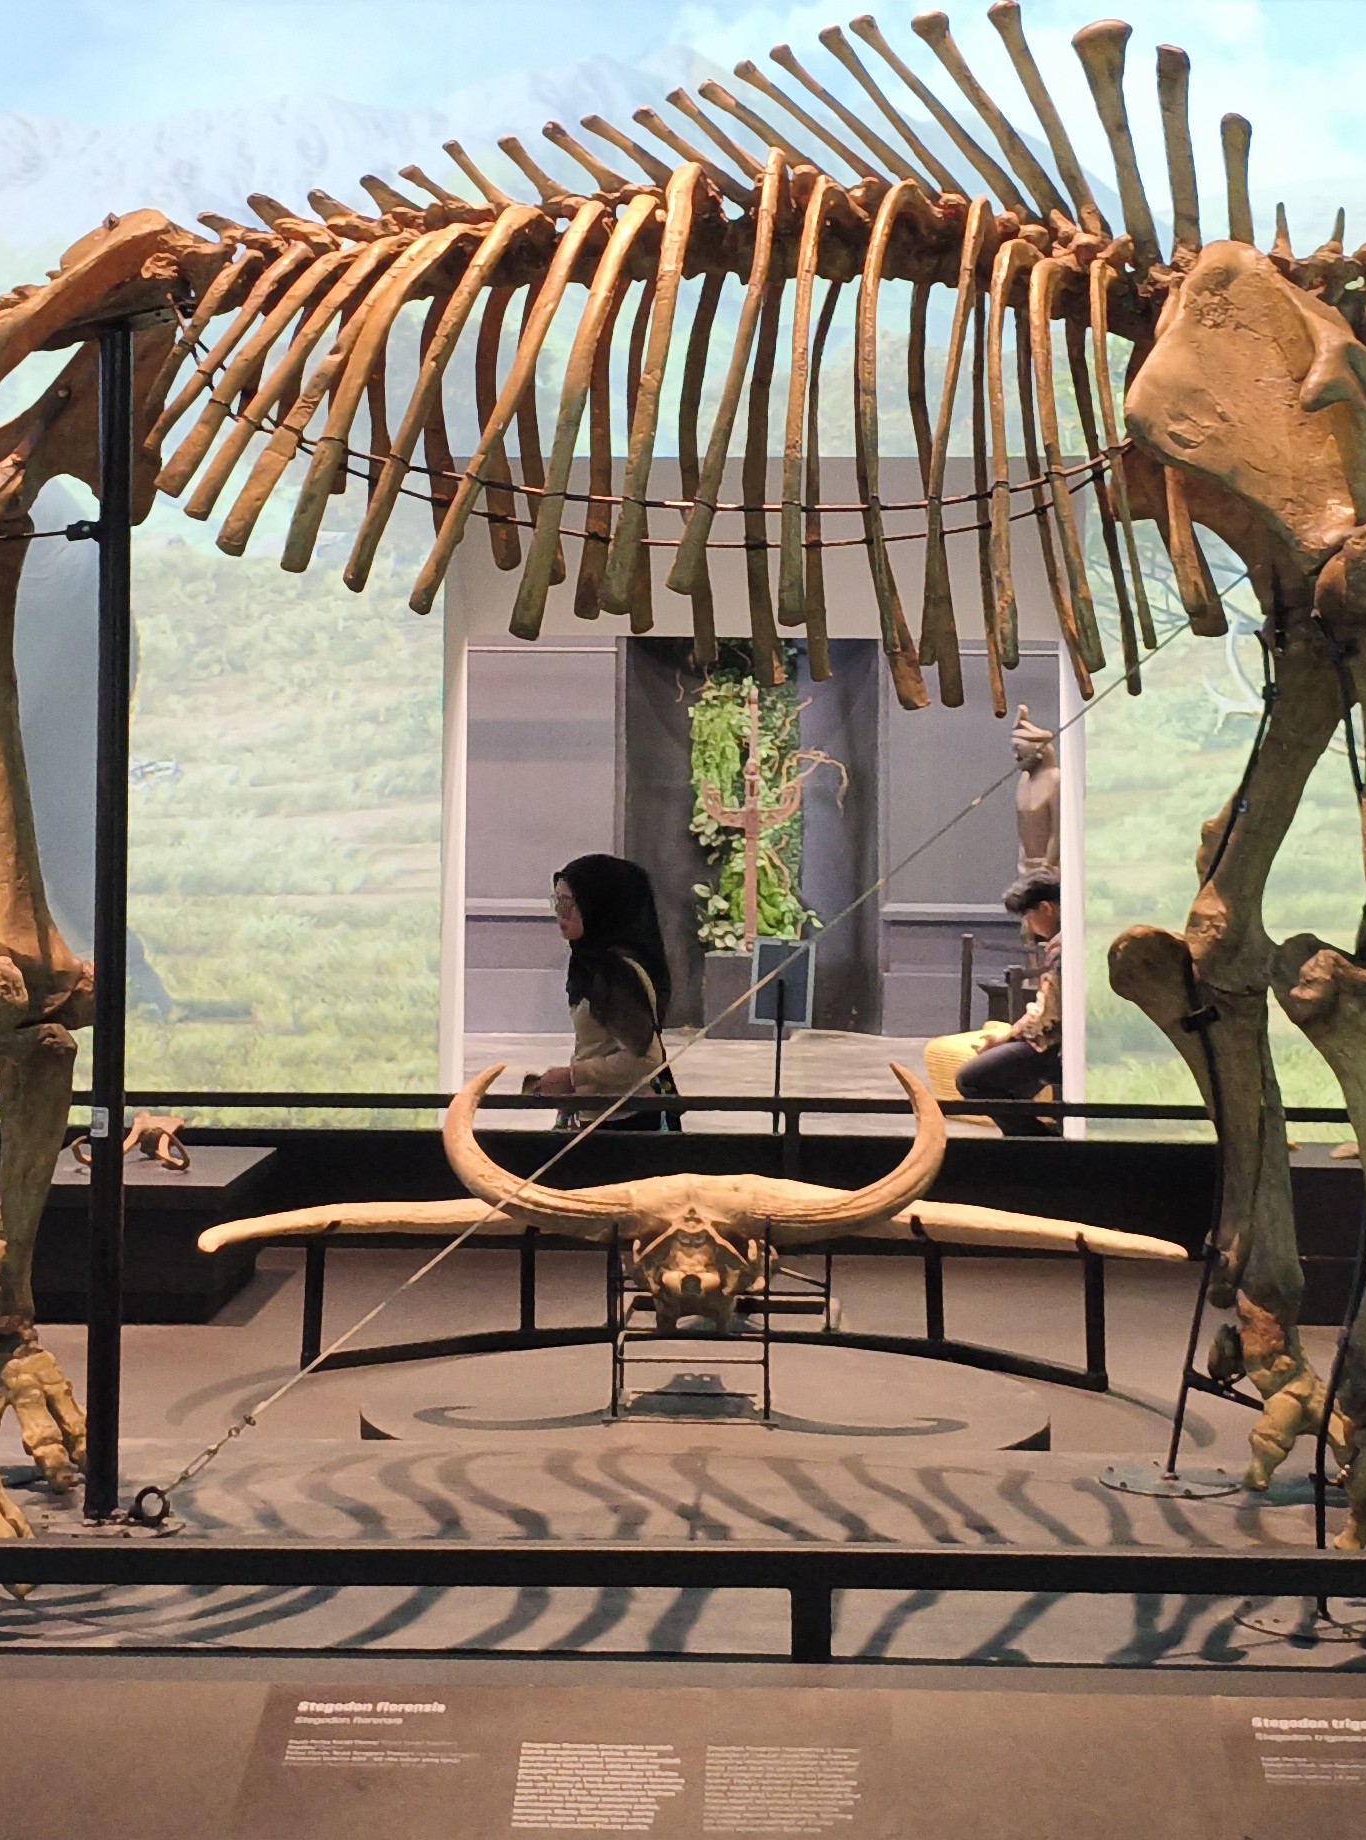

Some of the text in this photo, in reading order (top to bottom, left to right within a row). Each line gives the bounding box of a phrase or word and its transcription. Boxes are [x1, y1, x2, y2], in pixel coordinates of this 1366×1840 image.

[297, 1701, 446, 1714] Stegodon florensis
[1251, 1716, 1329, 1730] Stegodon
